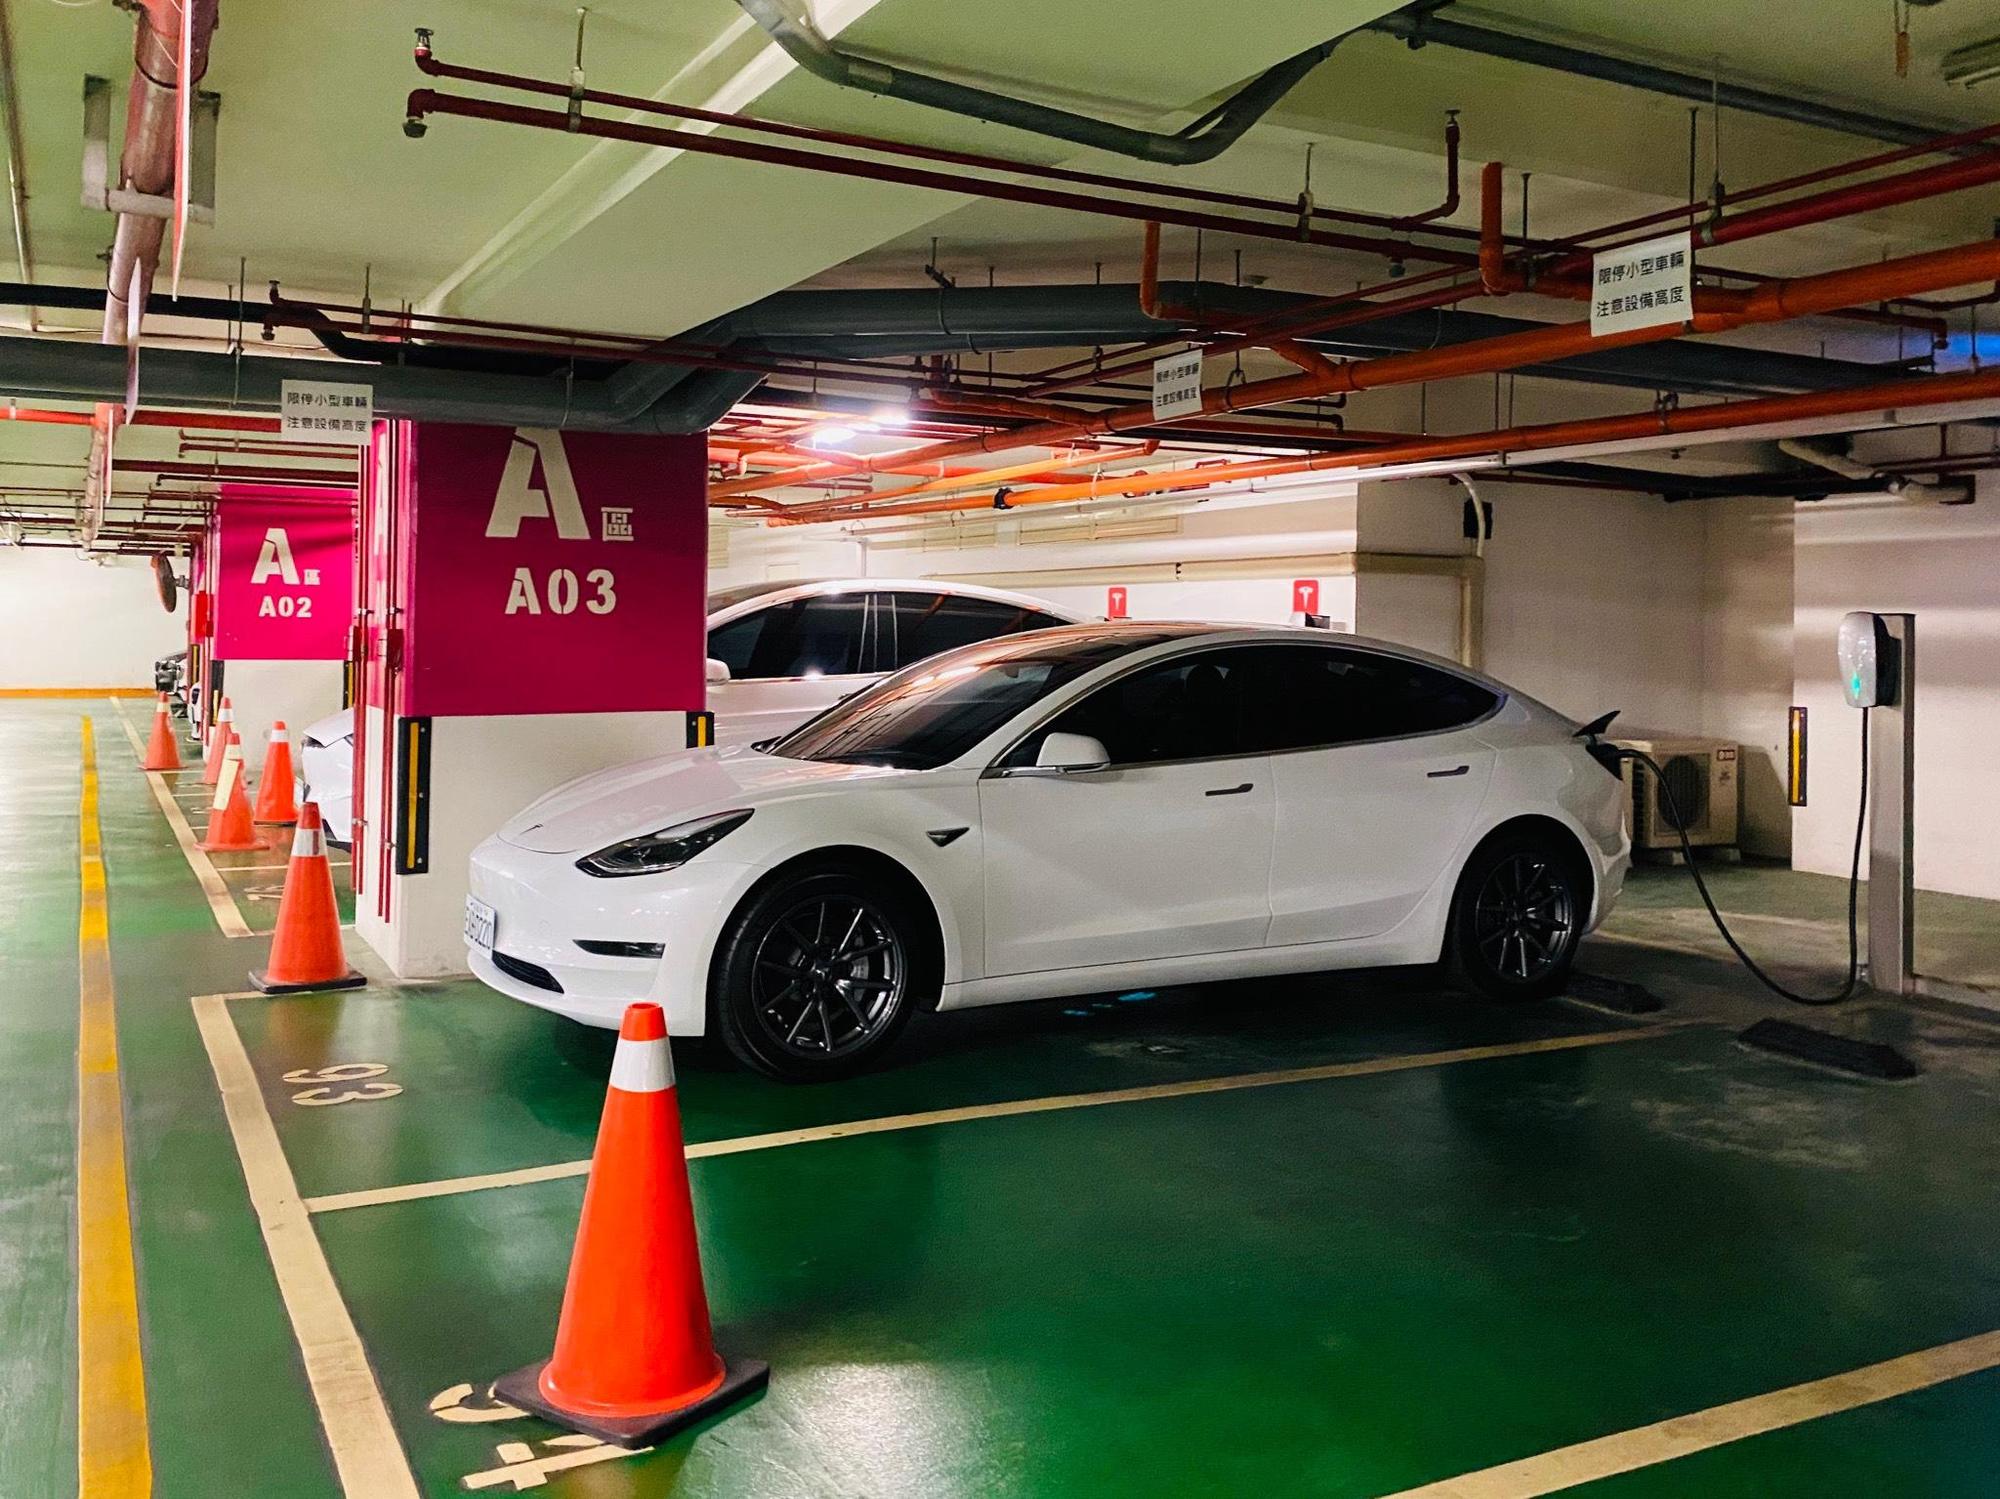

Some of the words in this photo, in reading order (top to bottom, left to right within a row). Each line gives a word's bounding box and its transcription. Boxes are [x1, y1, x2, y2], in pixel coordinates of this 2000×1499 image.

[1598, 250, 1685, 286] 限停小型車輛
[1596, 286, 1684, 318] 注意設備高度
[287, 392, 367, 407] 限停小型車輛
[287, 416, 367, 432] 注意設備高度
[258, 595, 312, 618] A02
[504, 567, 617, 615] A03
[282, 1062, 404, 1106] 93
